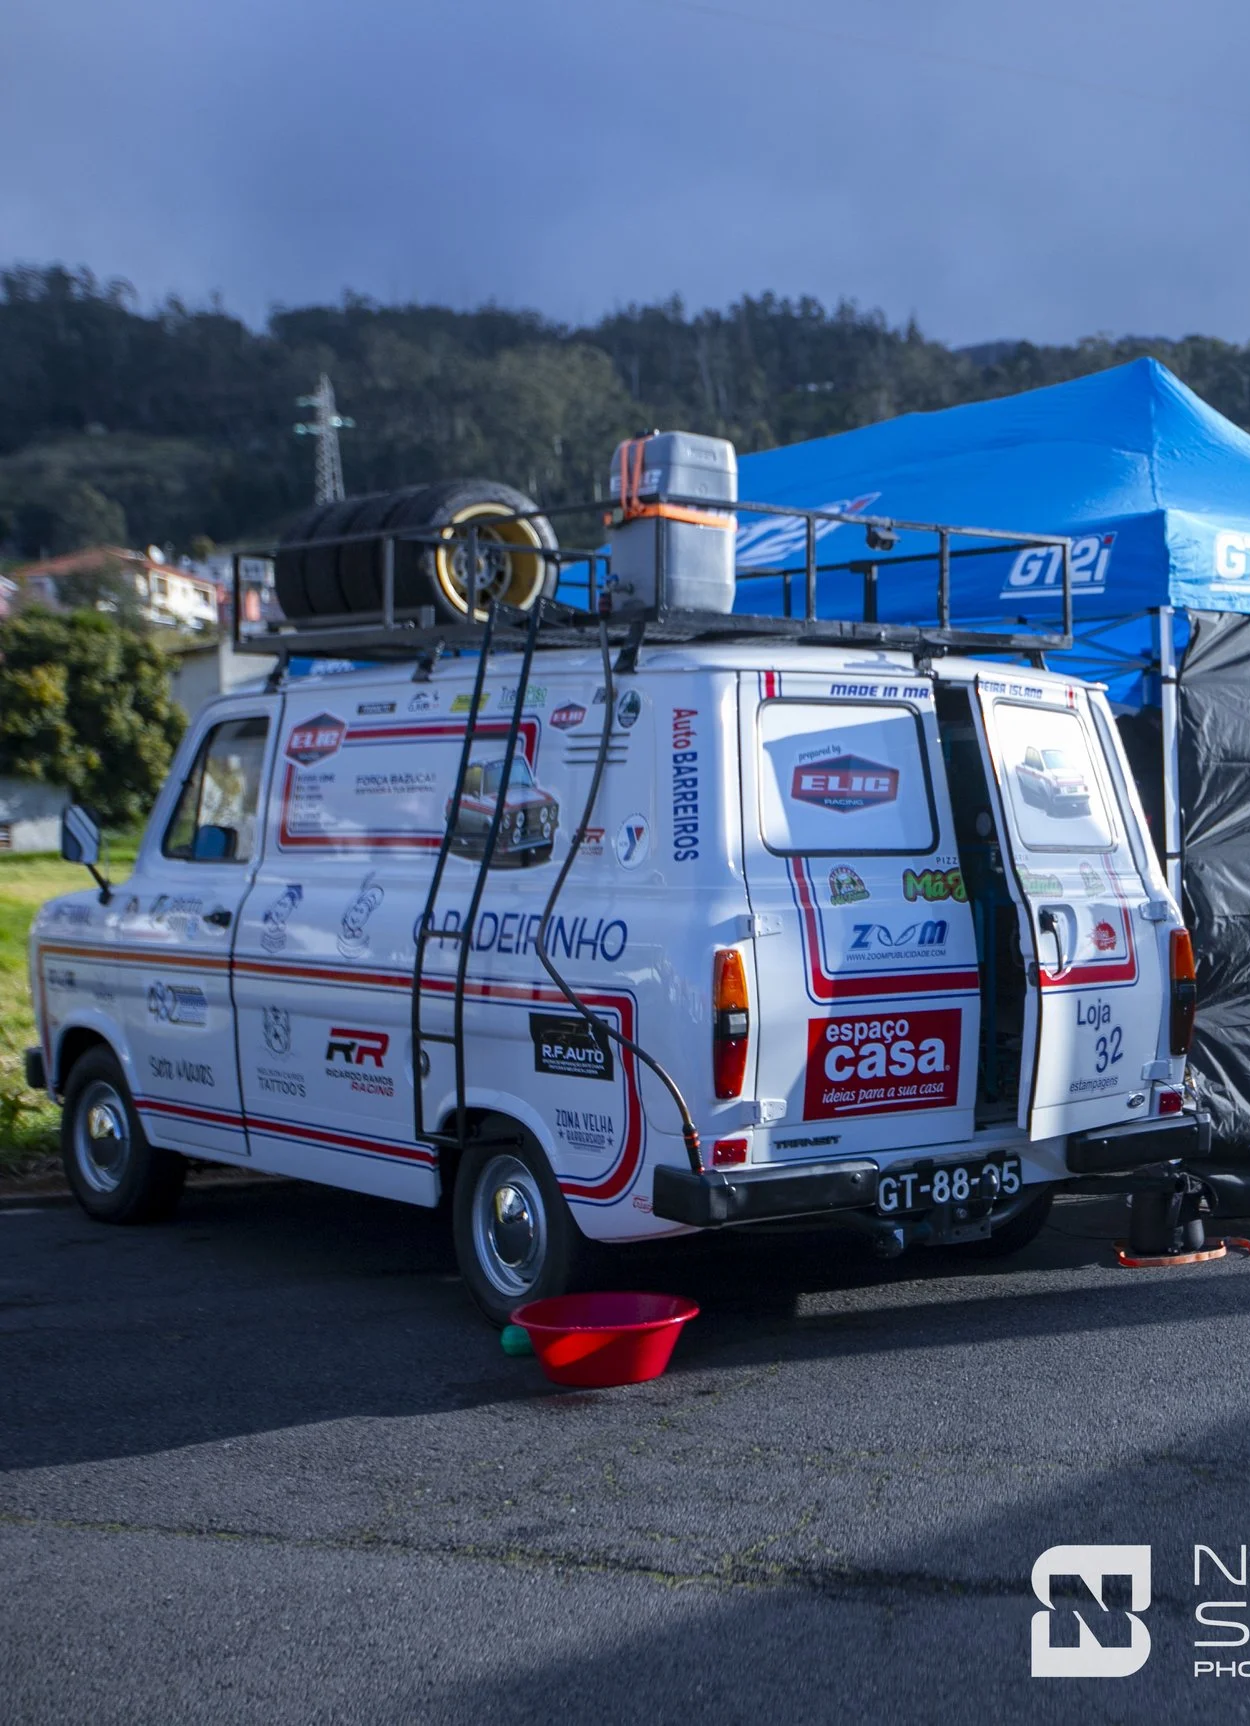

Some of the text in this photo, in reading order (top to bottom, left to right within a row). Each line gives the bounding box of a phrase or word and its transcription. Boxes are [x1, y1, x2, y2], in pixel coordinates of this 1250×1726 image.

[1008, 535, 1113, 587] GT2i
[831, 684, 878, 698] MADE
[882, 686, 899, 698] IN
[1008, 684, 1043, 699] ISLAND
[672, 708, 699, 862] Auto BARREIROS
[801, 775, 890, 792] ELIC
[824, 798, 865, 806] RACING
[846, 948, 947, 962] WWW.ZOOMPUBLICIDADE.COM
[1077, 999, 1111, 1031] Loja
[826, 1018, 909, 1046] espaço
[325, 1027, 389, 1068] RR
[542, 1043, 605, 1064] R.F.AUTO
[1095, 1026, 1123, 1073] 32
[824, 1038, 946, 1082] casa
[325, 1068, 394, 1087] RICARDO RAMOS
[1069, 1075, 1119, 1093] estampagens
[351, 1081, 394, 1097] RACING
[822, 1081, 945, 1104] ideias para a sua casa
[555, 1108, 614, 1134] ZONA VELHA
[773, 1135, 843, 1150] TRANSIT
